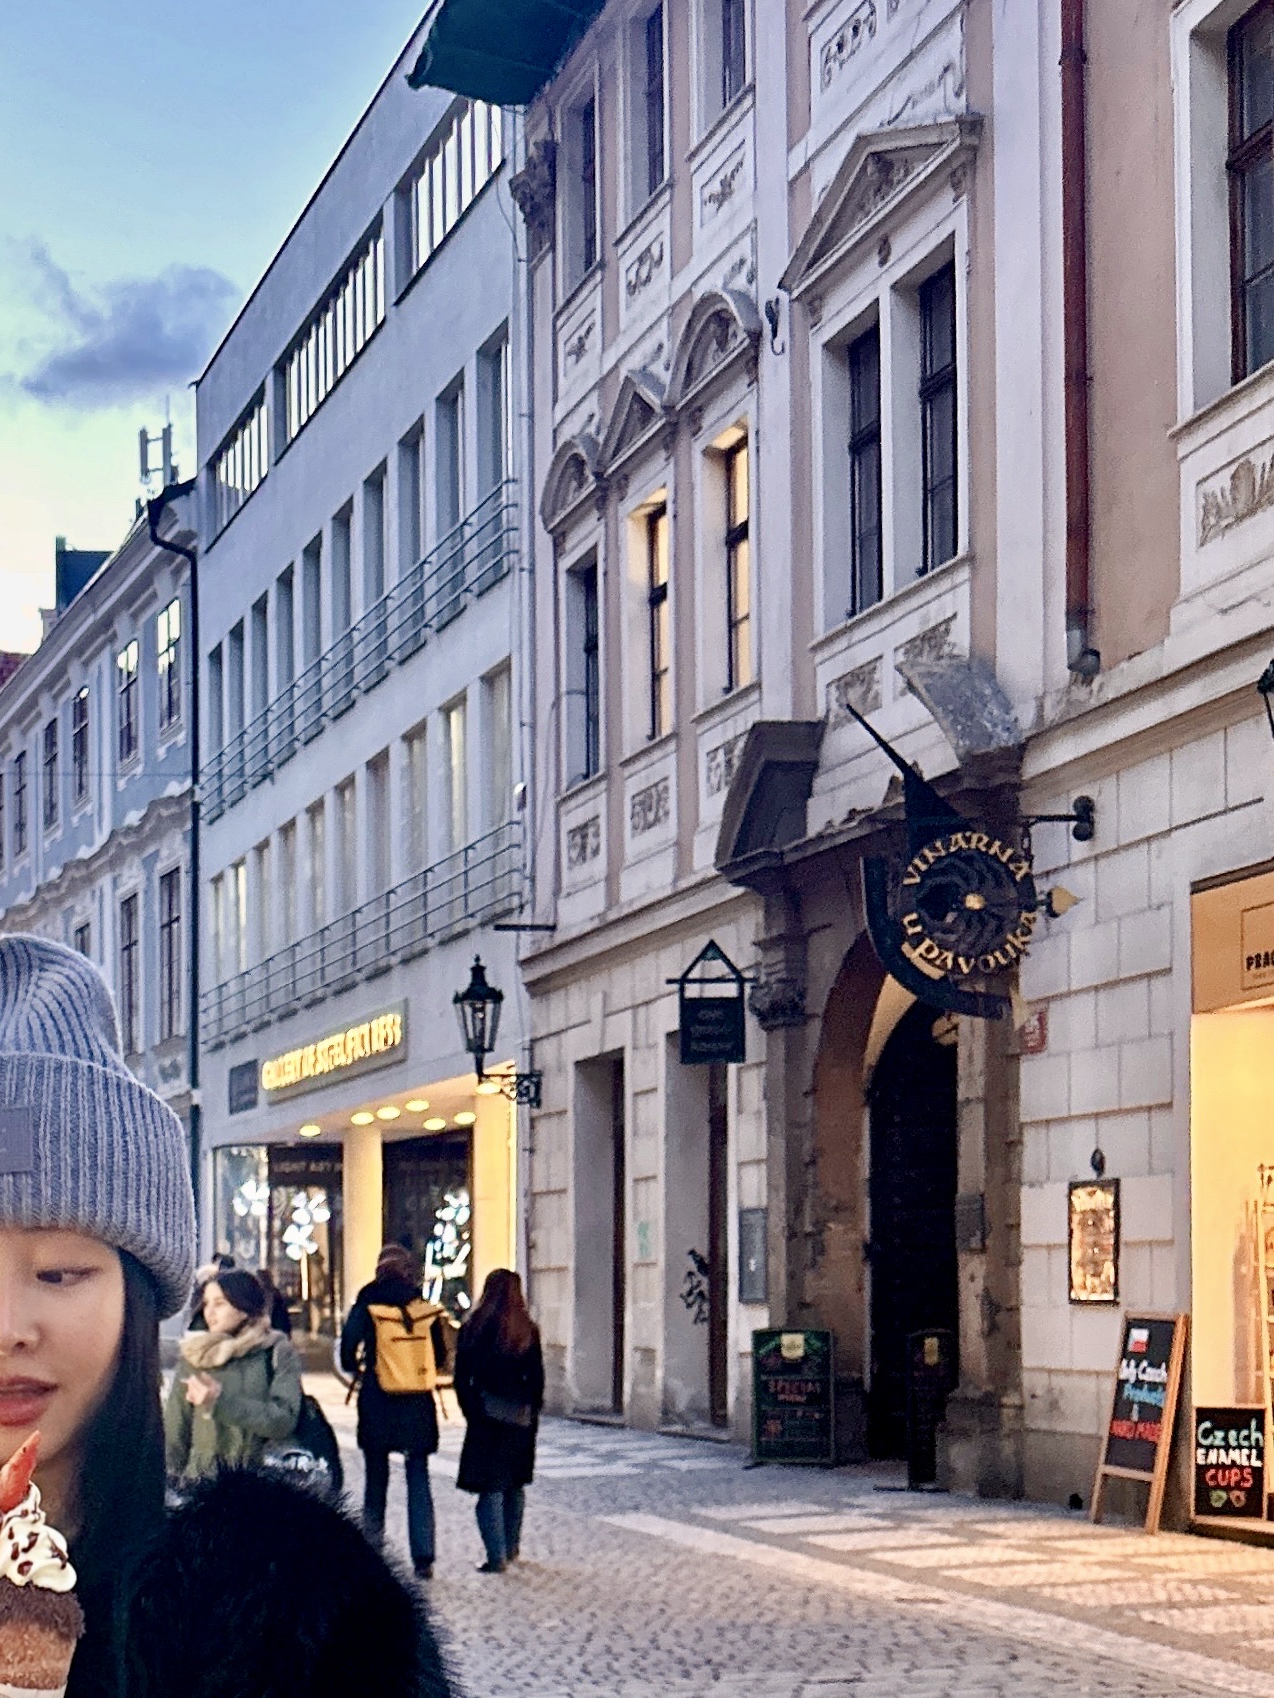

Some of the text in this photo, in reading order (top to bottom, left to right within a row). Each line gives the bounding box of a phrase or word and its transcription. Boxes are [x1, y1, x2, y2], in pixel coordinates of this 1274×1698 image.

[1197, 1417, 1264, 1447] Czech
[1196, 1447, 1263, 1468] ENAMEL
[1205, 1467, 1254, 1488] CUPS
